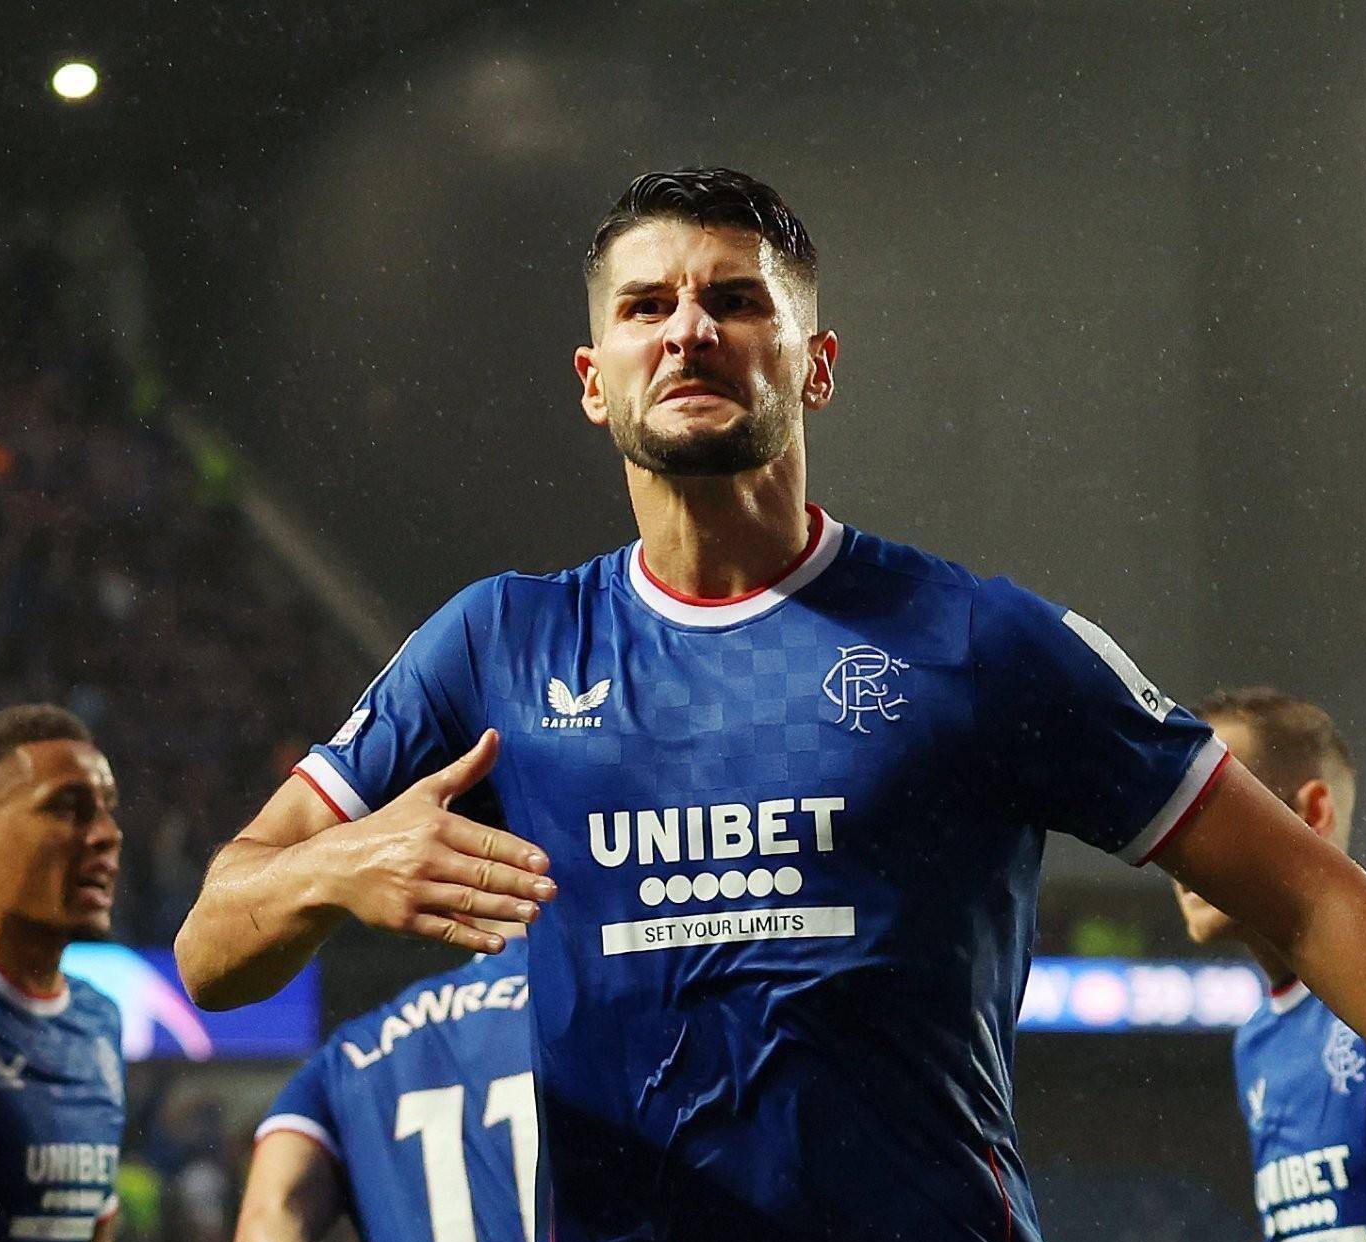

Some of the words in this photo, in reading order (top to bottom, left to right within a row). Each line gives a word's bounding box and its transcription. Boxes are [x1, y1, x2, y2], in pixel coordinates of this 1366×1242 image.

[541, 716, 603, 729] CASTORE
[588, 796, 845, 868] UNIBET
[644, 924, 677, 943] SET
[682, 919, 732, 939] YOUR
[738, 914, 805, 935] LIMITS
[340, 974, 530, 1070] LAWRE
